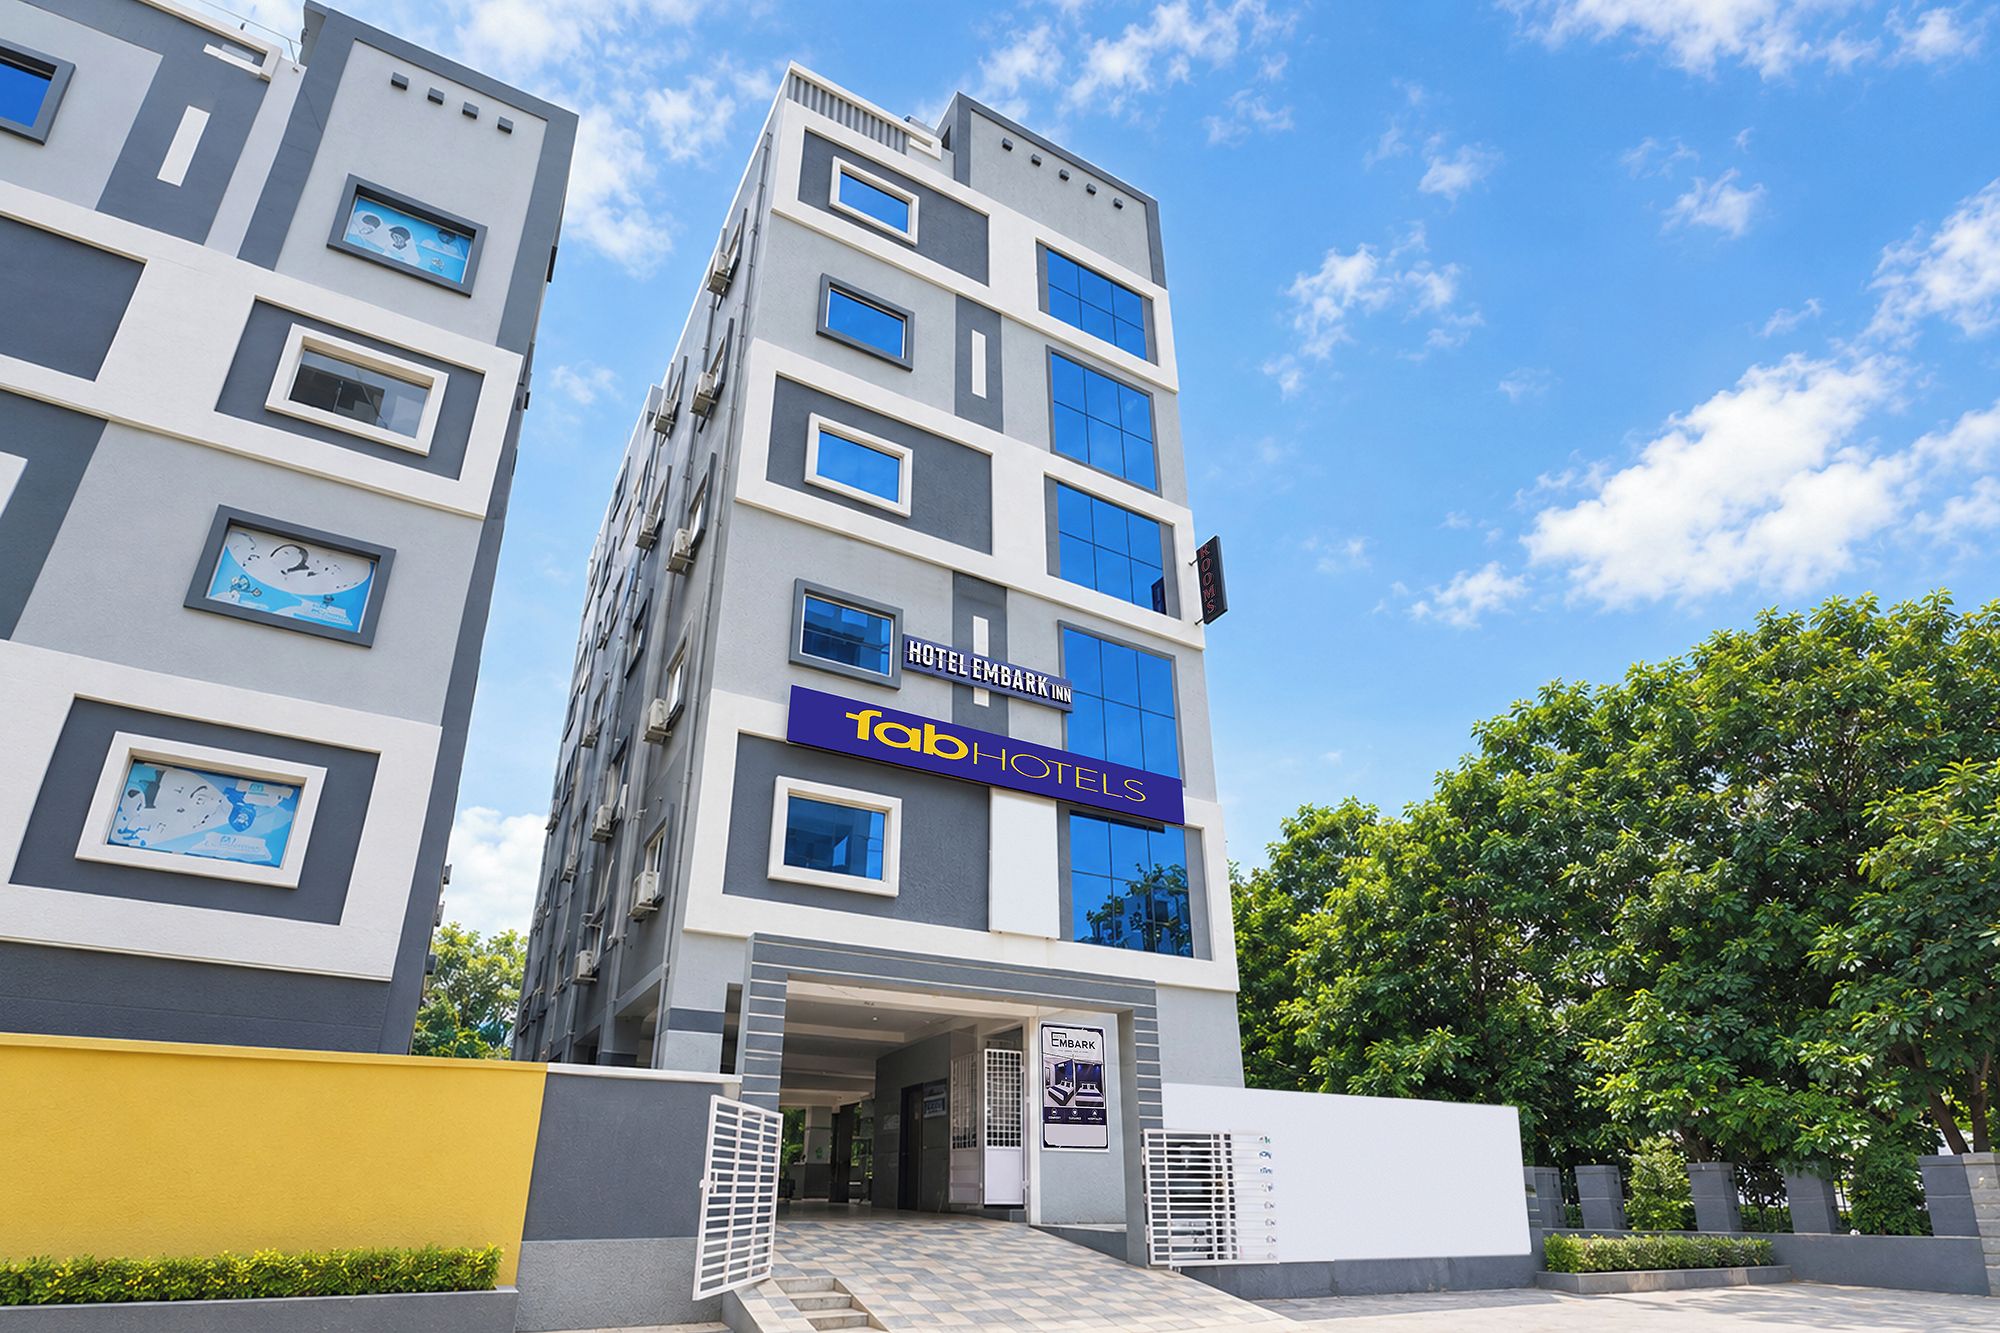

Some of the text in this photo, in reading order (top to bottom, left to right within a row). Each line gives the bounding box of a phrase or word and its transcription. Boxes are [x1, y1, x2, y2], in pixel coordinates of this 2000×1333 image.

[1199, 543, 1217, 614] ROOMS
[907, 640, 1072, 704] HOTEL EMBARK INN
[1051, 1031, 1096, 1050] EMBARK
